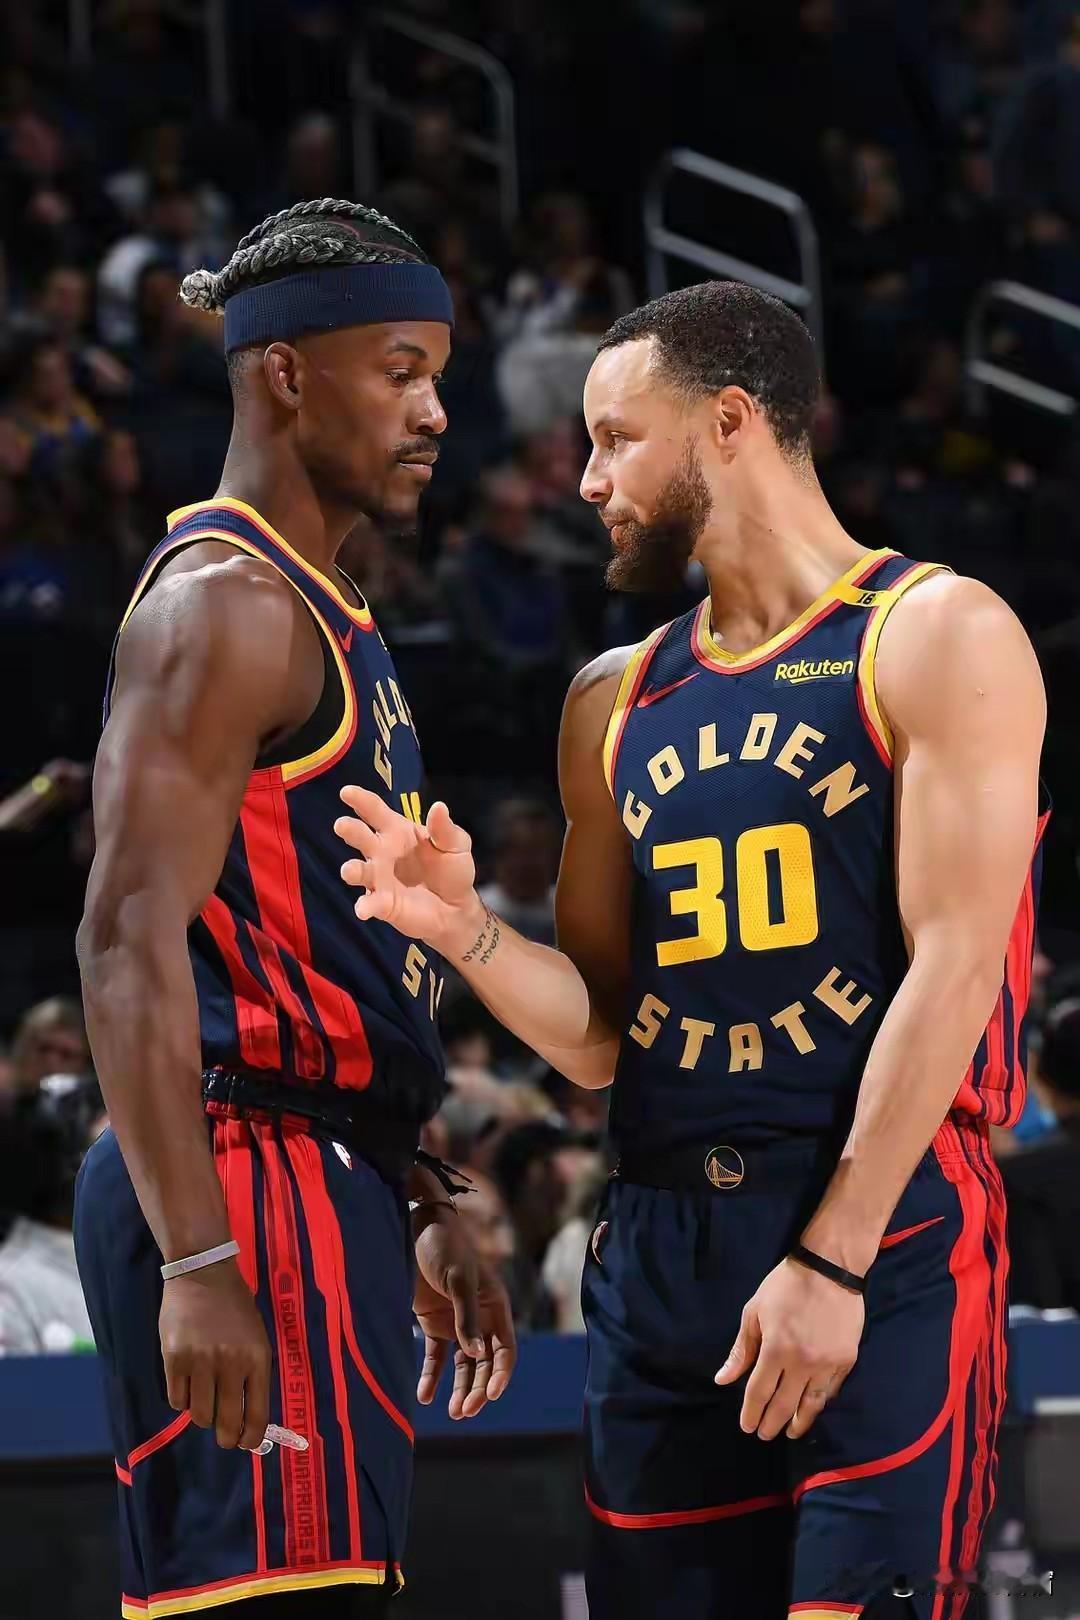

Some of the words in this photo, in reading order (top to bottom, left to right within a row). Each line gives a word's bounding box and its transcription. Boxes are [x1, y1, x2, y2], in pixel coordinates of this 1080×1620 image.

[774, 658, 855, 684] Rakuten
[373, 676, 421, 791] GOLD
[622, 712, 870, 840] GOLDEN
[652, 822, 819, 967] 30
[628, 966, 873, 1073] STATE
[287, 1382, 309, 1434] STAT
